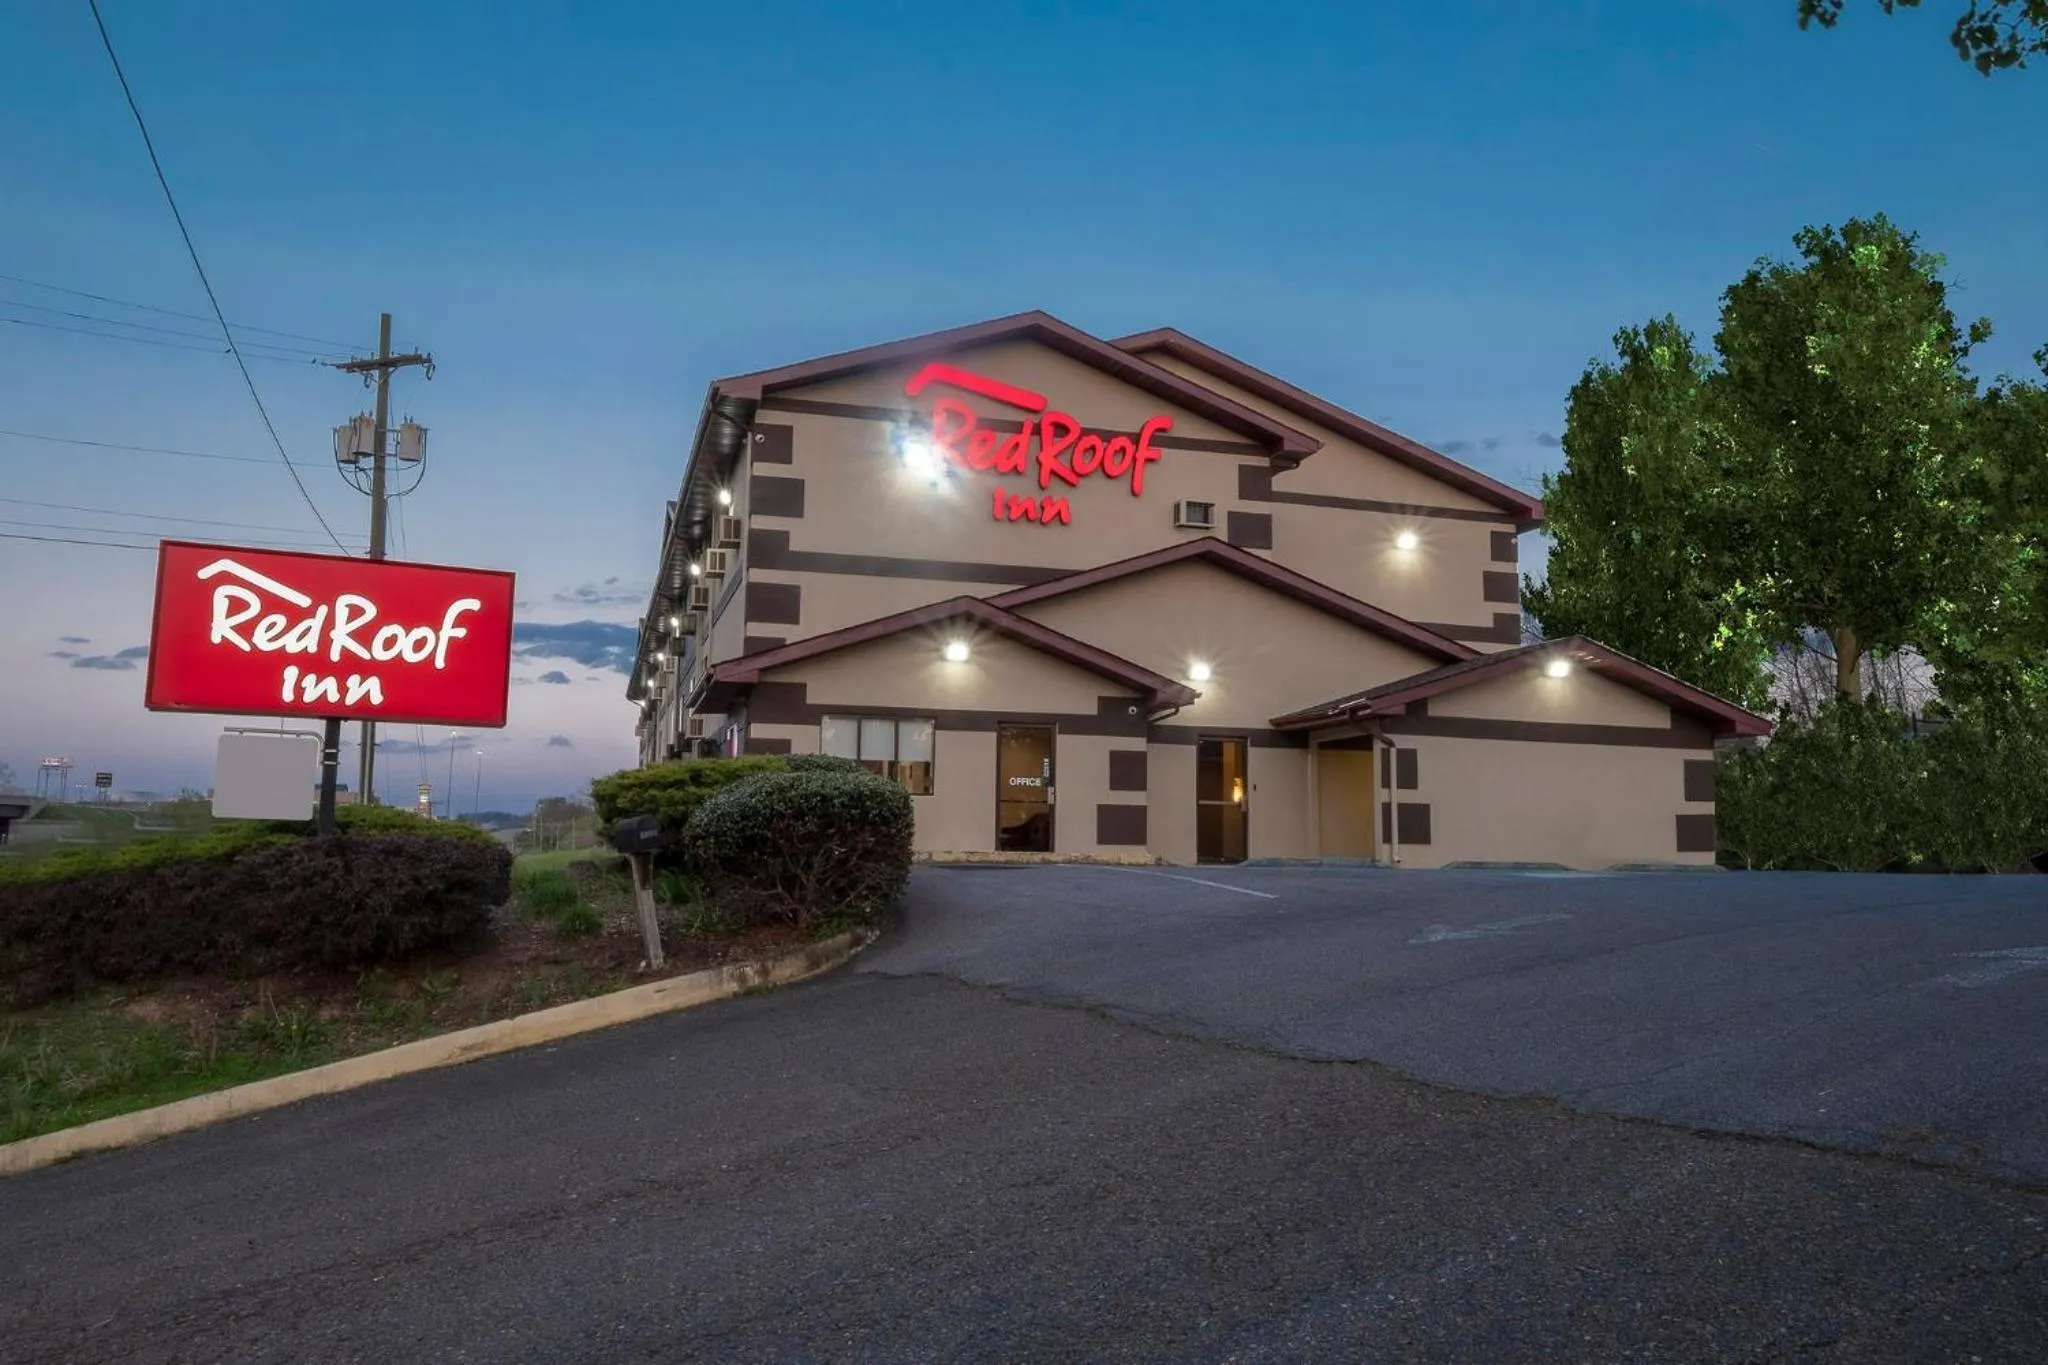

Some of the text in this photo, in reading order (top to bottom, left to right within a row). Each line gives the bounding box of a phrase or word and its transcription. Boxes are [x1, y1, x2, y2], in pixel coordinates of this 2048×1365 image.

[992, 486, 1072, 525] Inn
[282, 665, 384, 706] Inn
[1009, 777, 1042, 787] OFFICE
